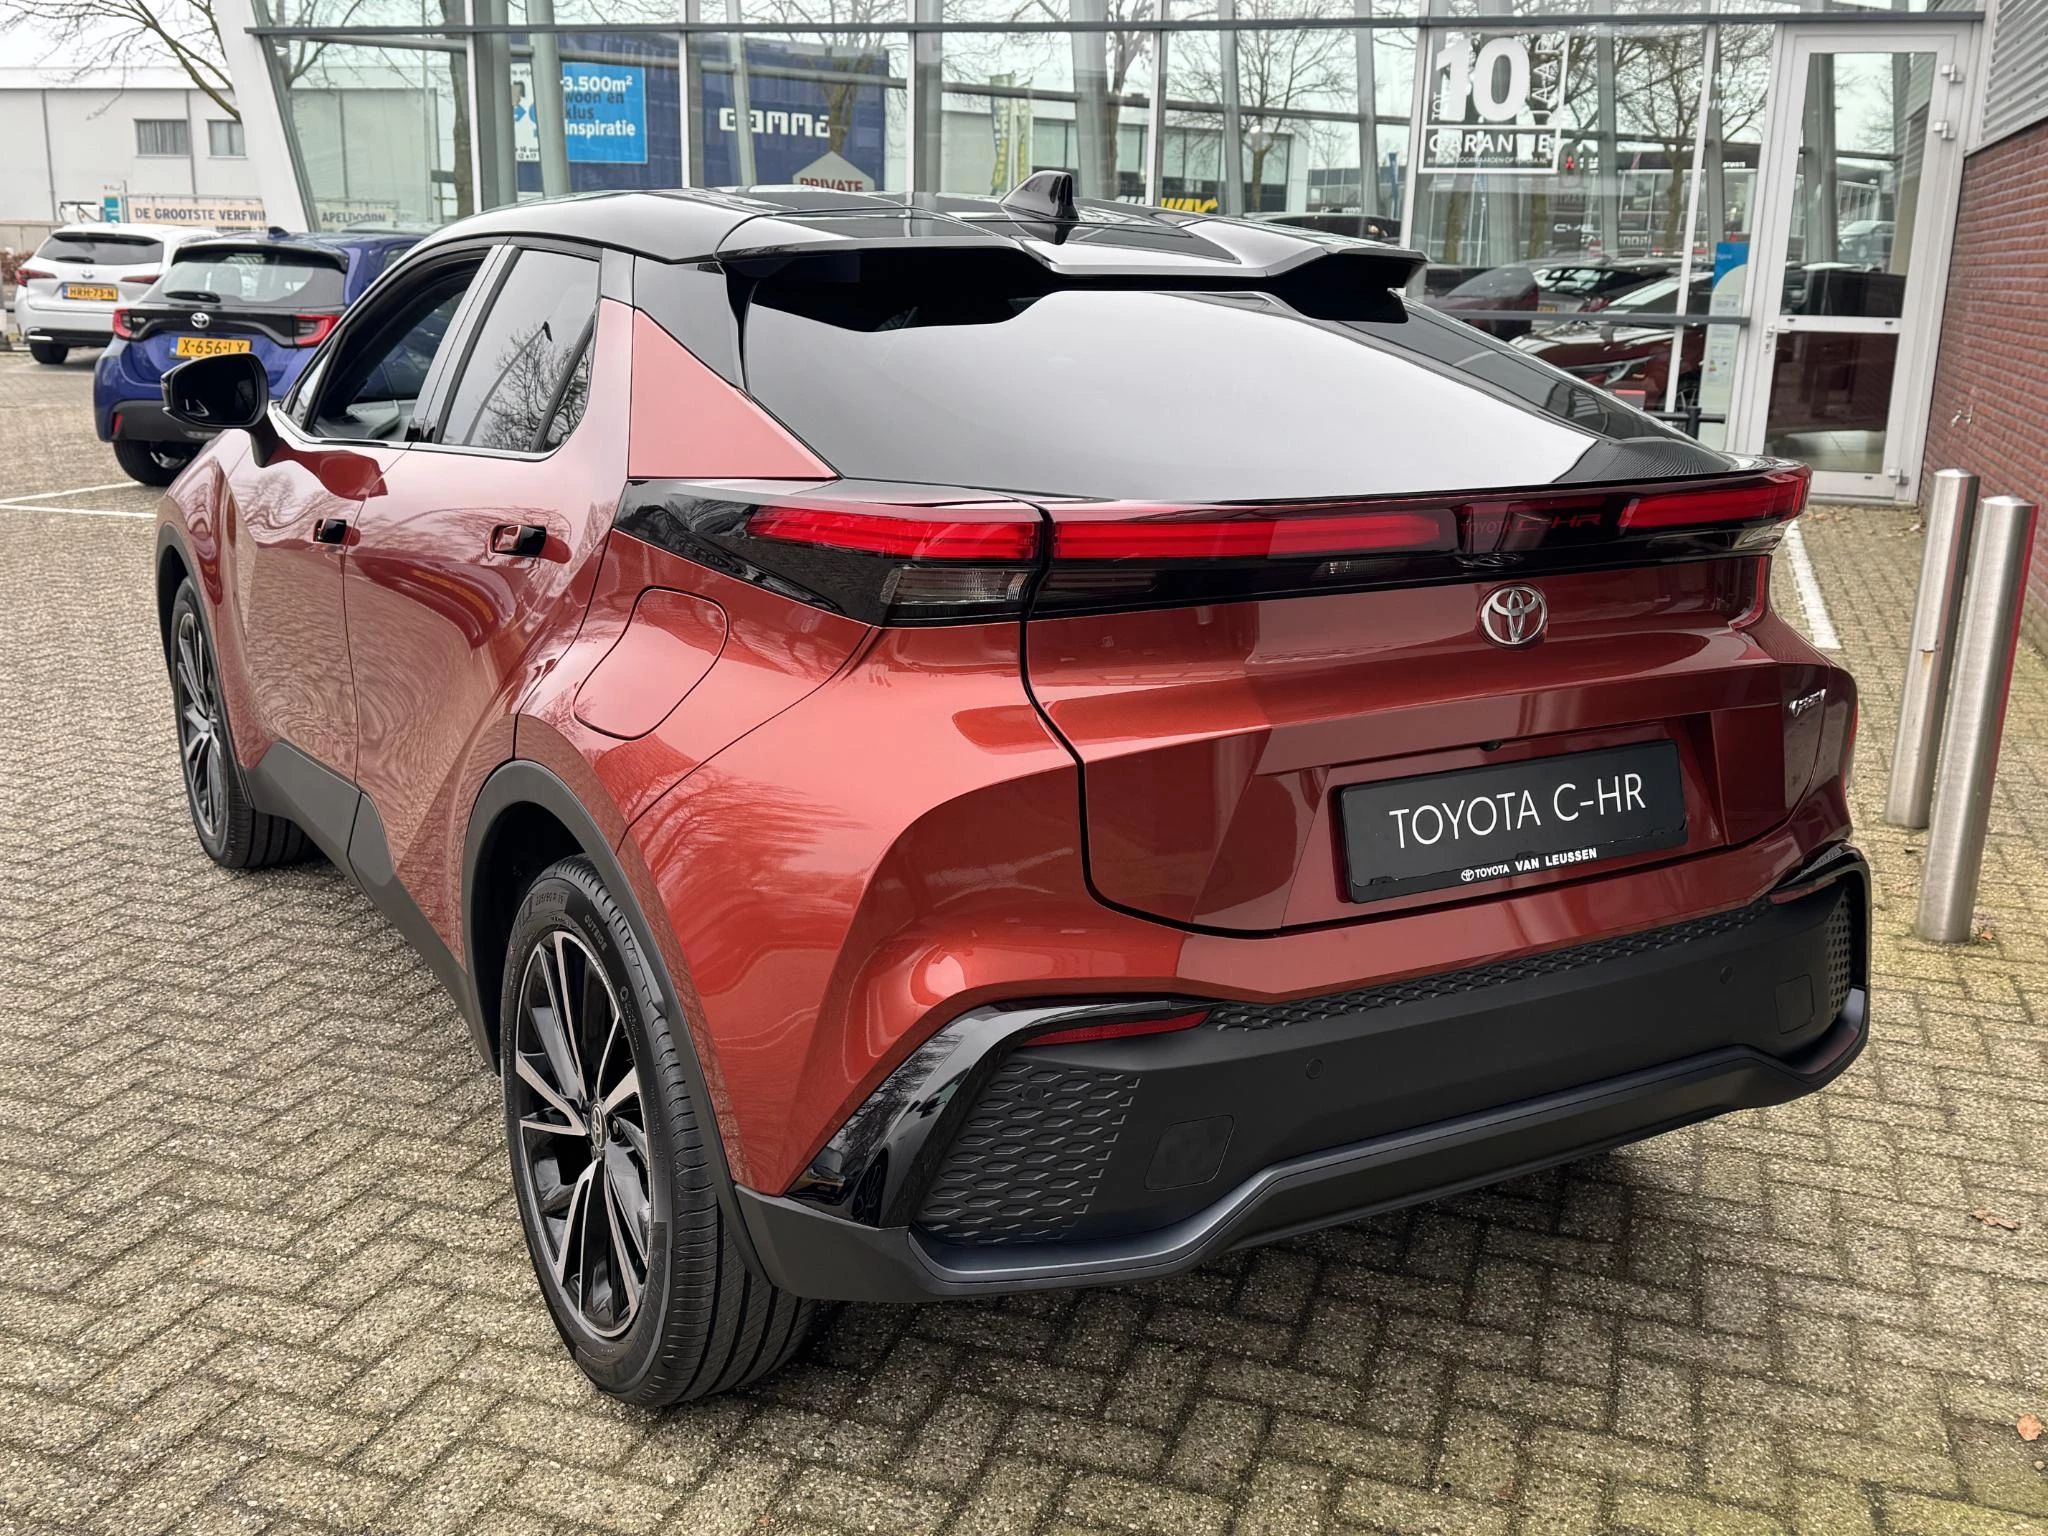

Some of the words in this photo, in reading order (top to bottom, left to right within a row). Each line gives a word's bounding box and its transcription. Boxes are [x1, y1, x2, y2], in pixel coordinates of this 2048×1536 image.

[560, 75, 633, 92] 3.500m²
[1436, 37, 1530, 122] 10
[607, 91, 625, 104] en
[564, 120, 636, 139] inspiratie
[135, 207, 151, 219] DE
[154, 208, 216, 220] GROOTSTE
[68, 286, 115, 299] HRH-73-N
[1389, 789, 1541, 848] TOYOTA
[1553, 773, 1646, 821] C-HR
[1474, 864, 1510, 879] TOYOTA
[1515, 857, 1540, 872] VAN
[1545, 847, 1597, 866] LEUSSEN
